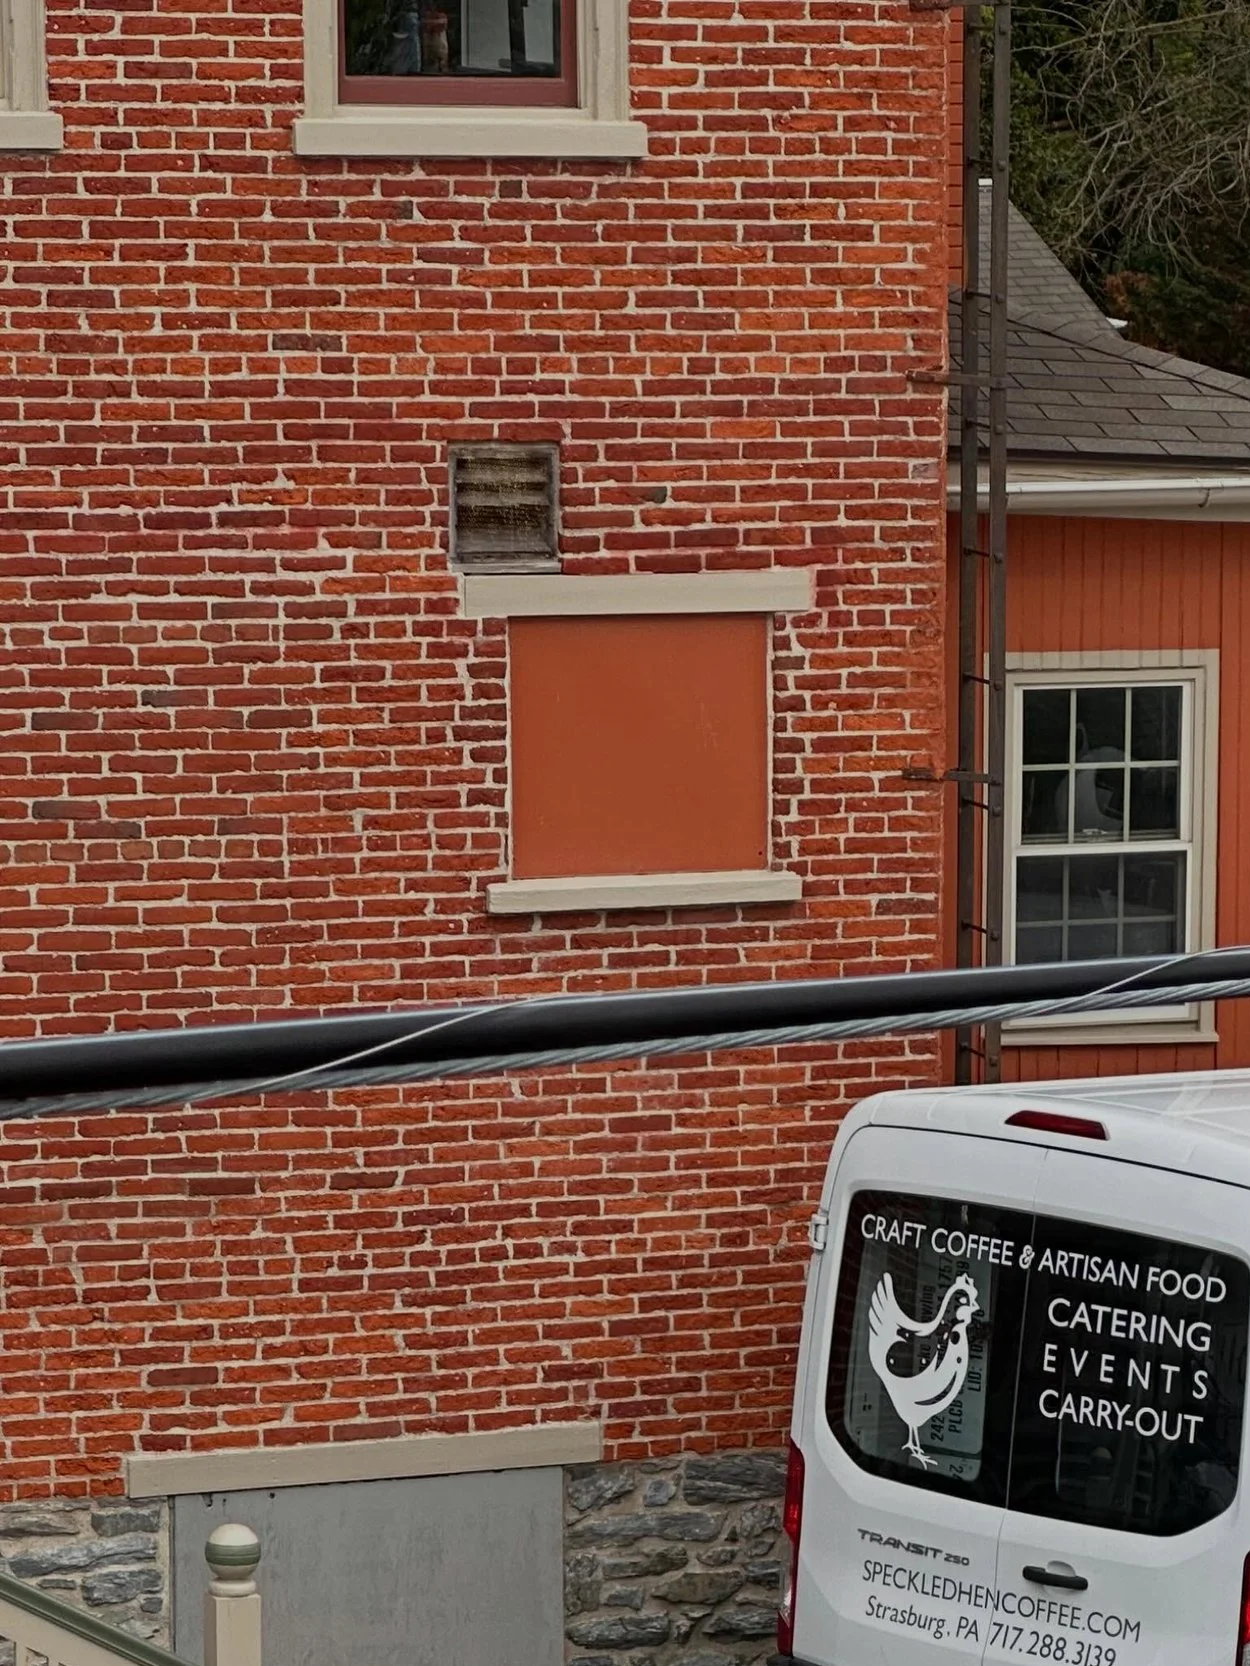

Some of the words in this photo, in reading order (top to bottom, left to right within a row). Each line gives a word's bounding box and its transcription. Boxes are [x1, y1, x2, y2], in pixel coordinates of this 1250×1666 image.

[861, 1213, 927, 1250] CRAFT
[931, 1228, 1014, 1266] COFFEE
[1019, 1244, 1035, 1269] &
[1038, 1248, 1139, 1289] ARTISAN
[1146, 1267, 1227, 1303] FOOD
[1048, 1298, 1212, 1352] CATERING
[1043, 1343, 1208, 1400] EVENTS
[1039, 1389, 1204, 1444] CARRY-OUT
[858, 1528, 943, 1559] TRANSIT
[943, 1552, 970, 1567] 250
[862, 1559, 1141, 1643] SPECKLEDHENCOFFEE.COM
[865, 1595, 950, 1640] Strasburg,
[956, 1615, 979, 1643] PA
